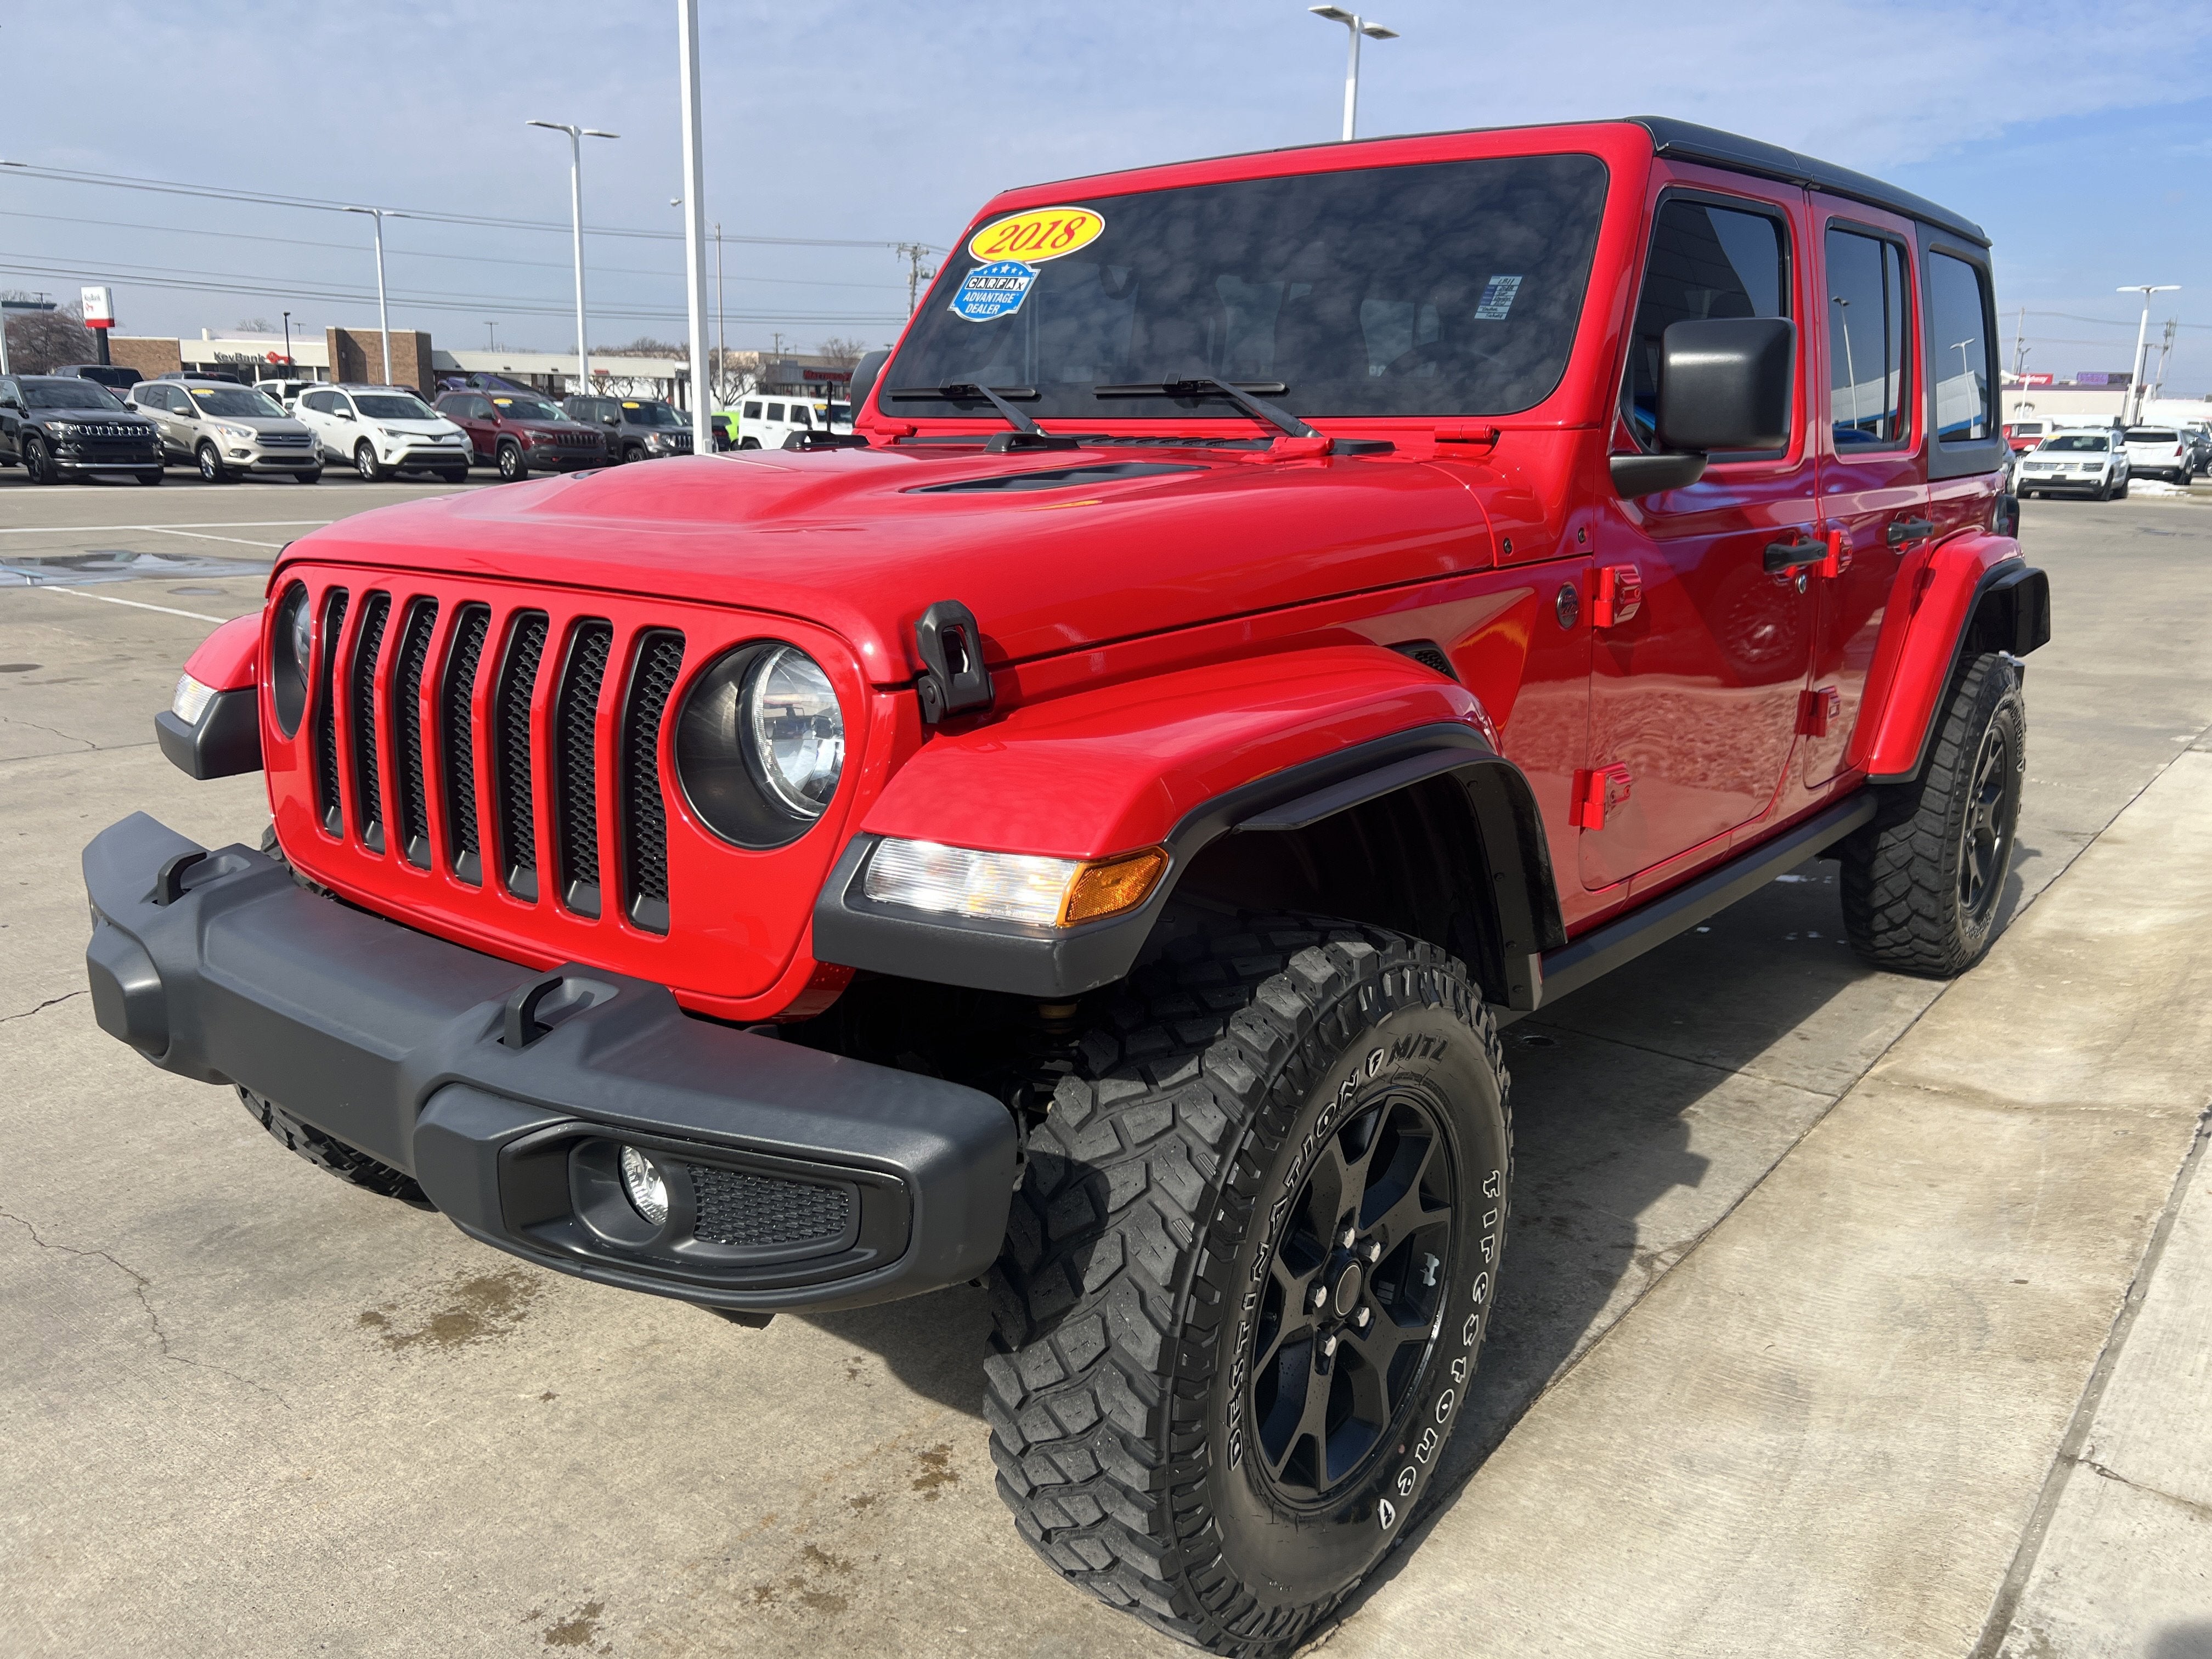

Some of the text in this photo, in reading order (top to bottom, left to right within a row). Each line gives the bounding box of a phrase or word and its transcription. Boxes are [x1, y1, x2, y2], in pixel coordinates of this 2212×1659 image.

[983, 217, 1087, 255] 2018
[966, 276, 1025, 291] CARFAX
[963, 292, 1015, 303] ADVANTAGE
[965, 304, 1001, 315] DEALER
[214, 351, 267, 364] KeyBank
[1227, 1065, 1360, 1471] DESTINATION
